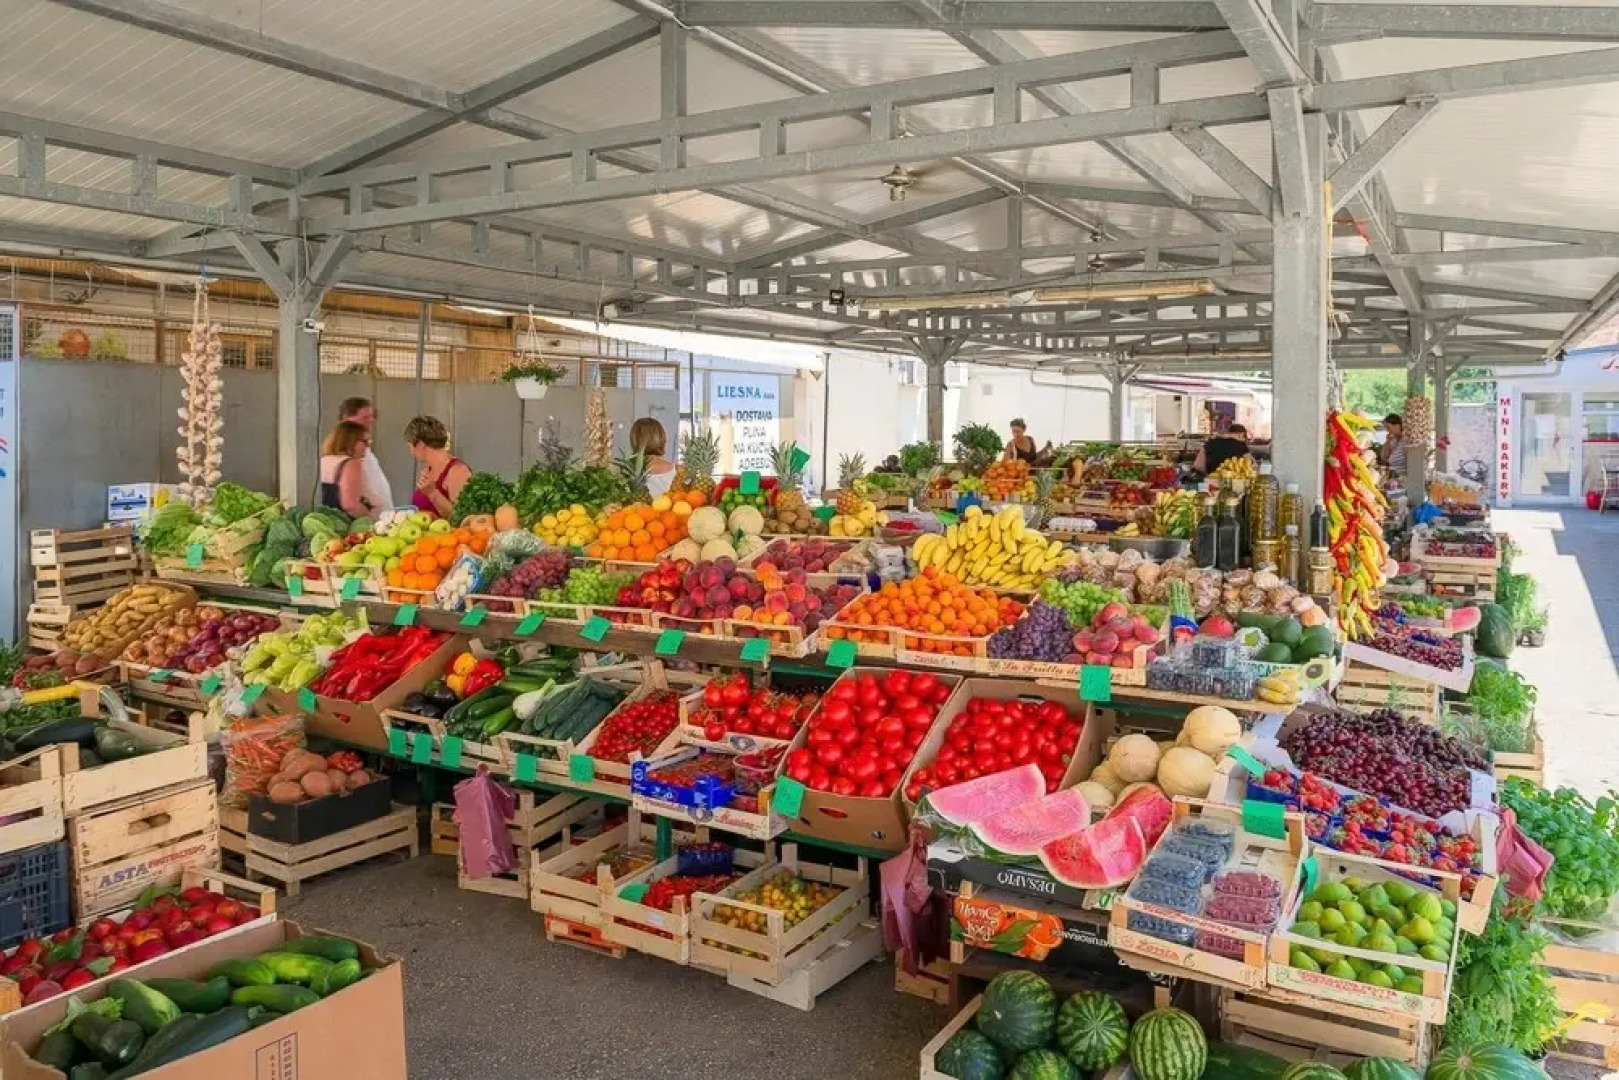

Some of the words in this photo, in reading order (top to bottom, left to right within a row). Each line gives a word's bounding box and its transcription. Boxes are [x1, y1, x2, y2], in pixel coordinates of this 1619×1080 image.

[717, 386, 761, 398] LIESNA
[736, 410, 773, 421] DOSTAVA
[1500, 398, 1511, 436] MINI
[1500, 442, 1510, 499] BAKERY
[99, 862, 149, 889] ASTA
